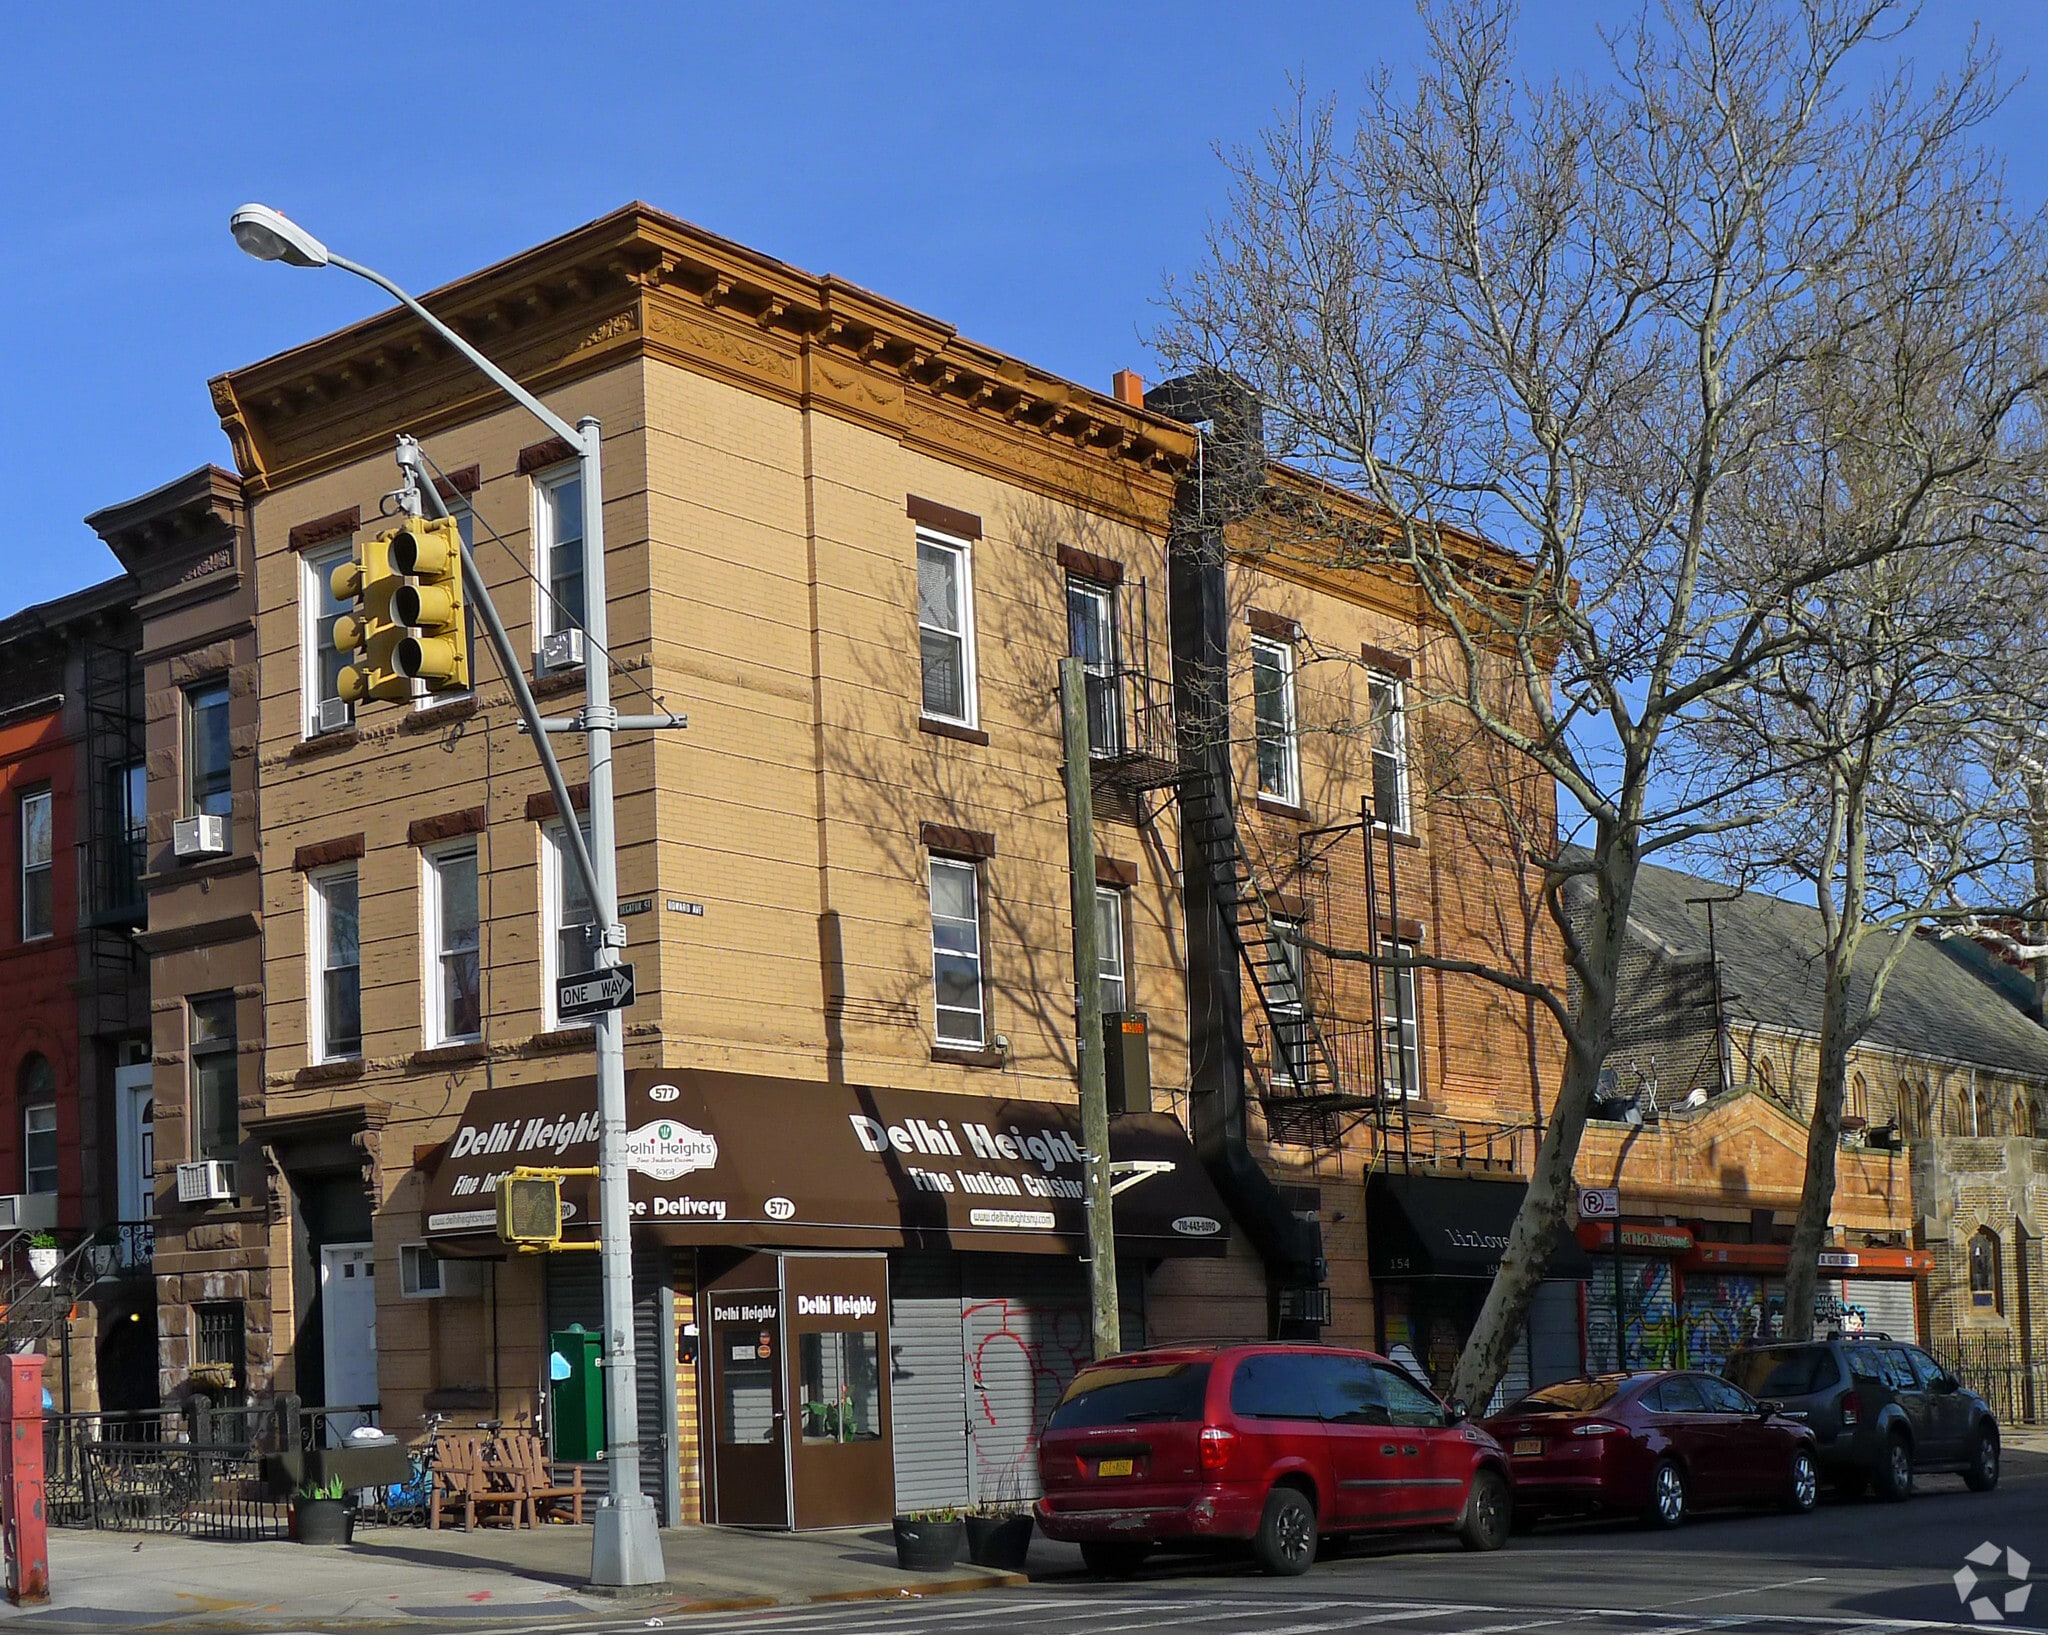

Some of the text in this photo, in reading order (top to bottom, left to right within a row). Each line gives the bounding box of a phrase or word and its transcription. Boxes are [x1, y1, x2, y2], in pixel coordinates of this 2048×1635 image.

[563, 978, 624, 1005] ONE WAY
[655, 1088, 675, 1099] 577
[450, 1110, 600, 1159] Delhi Height
[848, 1114, 1083, 1171] Delhi Height
[660, 1138, 711, 1157] Heights
[451, 1175, 480, 1197] Fine
[908, 1166, 955, 1193] Fine
[955, 1169, 1022, 1197] Indian
[654, 1196, 727, 1220] Delivery
[770, 1201, 790, 1216] 577
[1390, 1258, 1410, 1269] 154
[714, 1305, 776, 1323] Delhi Heights
[797, 1294, 877, 1320] Delhi Heights
